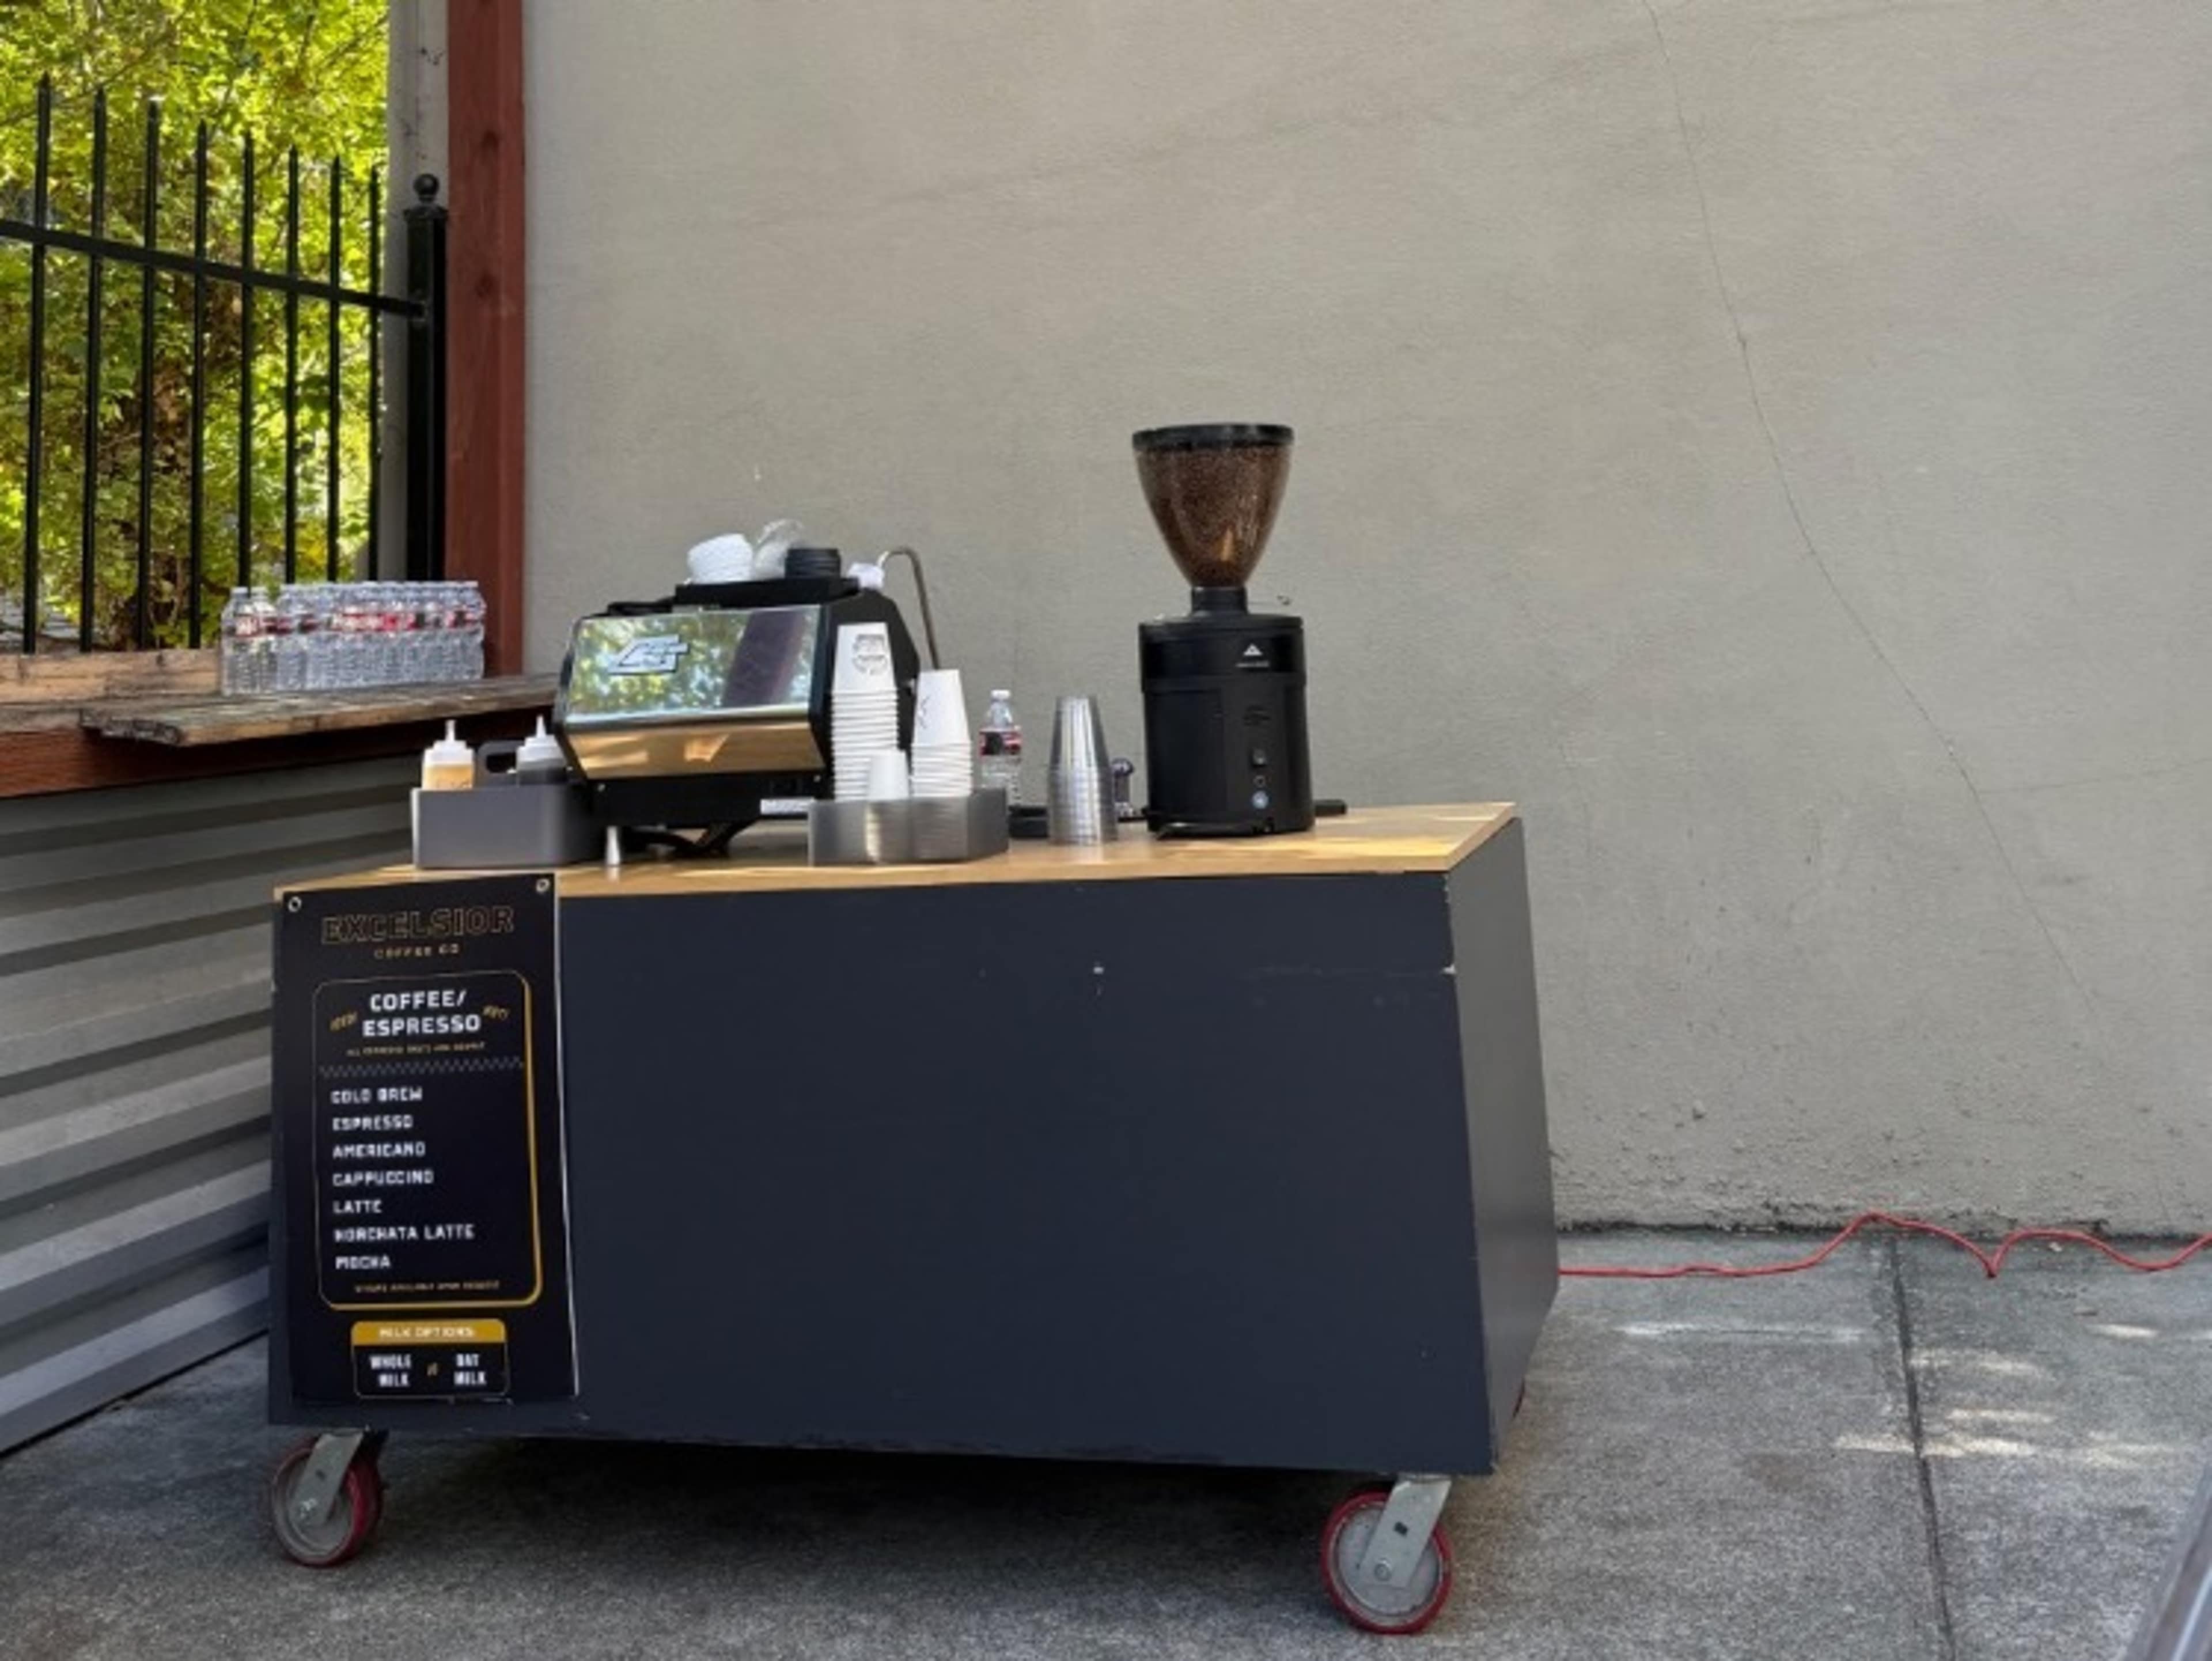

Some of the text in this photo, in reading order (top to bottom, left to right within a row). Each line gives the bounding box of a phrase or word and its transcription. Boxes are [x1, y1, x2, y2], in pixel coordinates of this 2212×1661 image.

[321, 905, 514, 945] EXCELSIOR
[370, 990, 467, 1012] COFFEE/
[362, 1014, 482, 1037] ESPRESSO
[331, 1086, 423, 1104] COLD BREW
[332, 1115, 413, 1131] ESPRESSO
[333, 1142, 426, 1159] AMERICANO
[332, 1169, 434, 1186] CAPPUCCINO
[333, 1200, 382, 1214] LATTE
[334, 1224, 475, 1243] HORCHATA LATTE
[335, 1255, 392, 1270] MOCHA
[415, 1326, 475, 1338] OPTIONS
